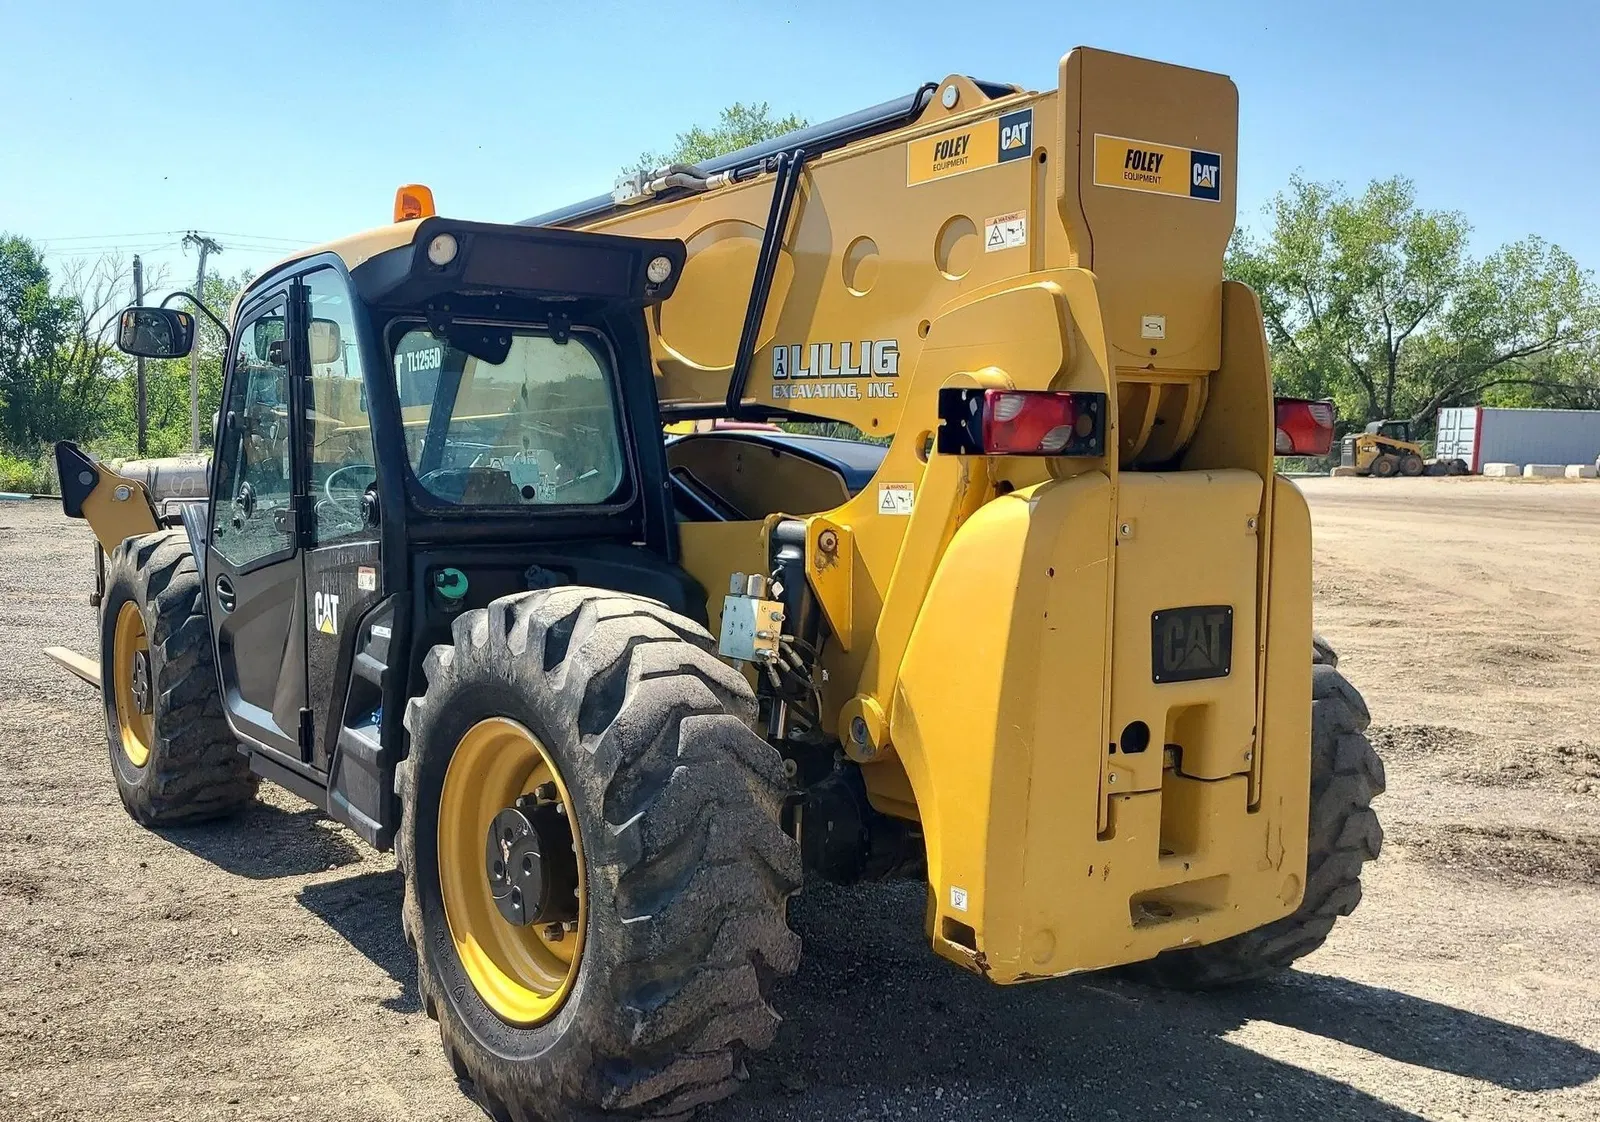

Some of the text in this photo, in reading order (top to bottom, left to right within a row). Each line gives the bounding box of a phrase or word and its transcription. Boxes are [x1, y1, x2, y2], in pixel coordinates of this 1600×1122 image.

[934, 134, 971, 162] FOLEY
[1001, 121, 1029, 151] CAT
[932, 156, 969, 172] EQUIPMENT
[1124, 149, 1163, 173] FOLEY
[1123, 171, 1162, 185] EQUIPMENT
[1193, 163, 1218, 188] CAT
[407, 347, 441, 372] TL1255D
[790, 339, 899, 378] LILLIG
[772, 382, 899, 400] EXCAVATING, INC.
[314, 591, 340, 635] CAT
[1163, 613, 1226, 672] CAT
